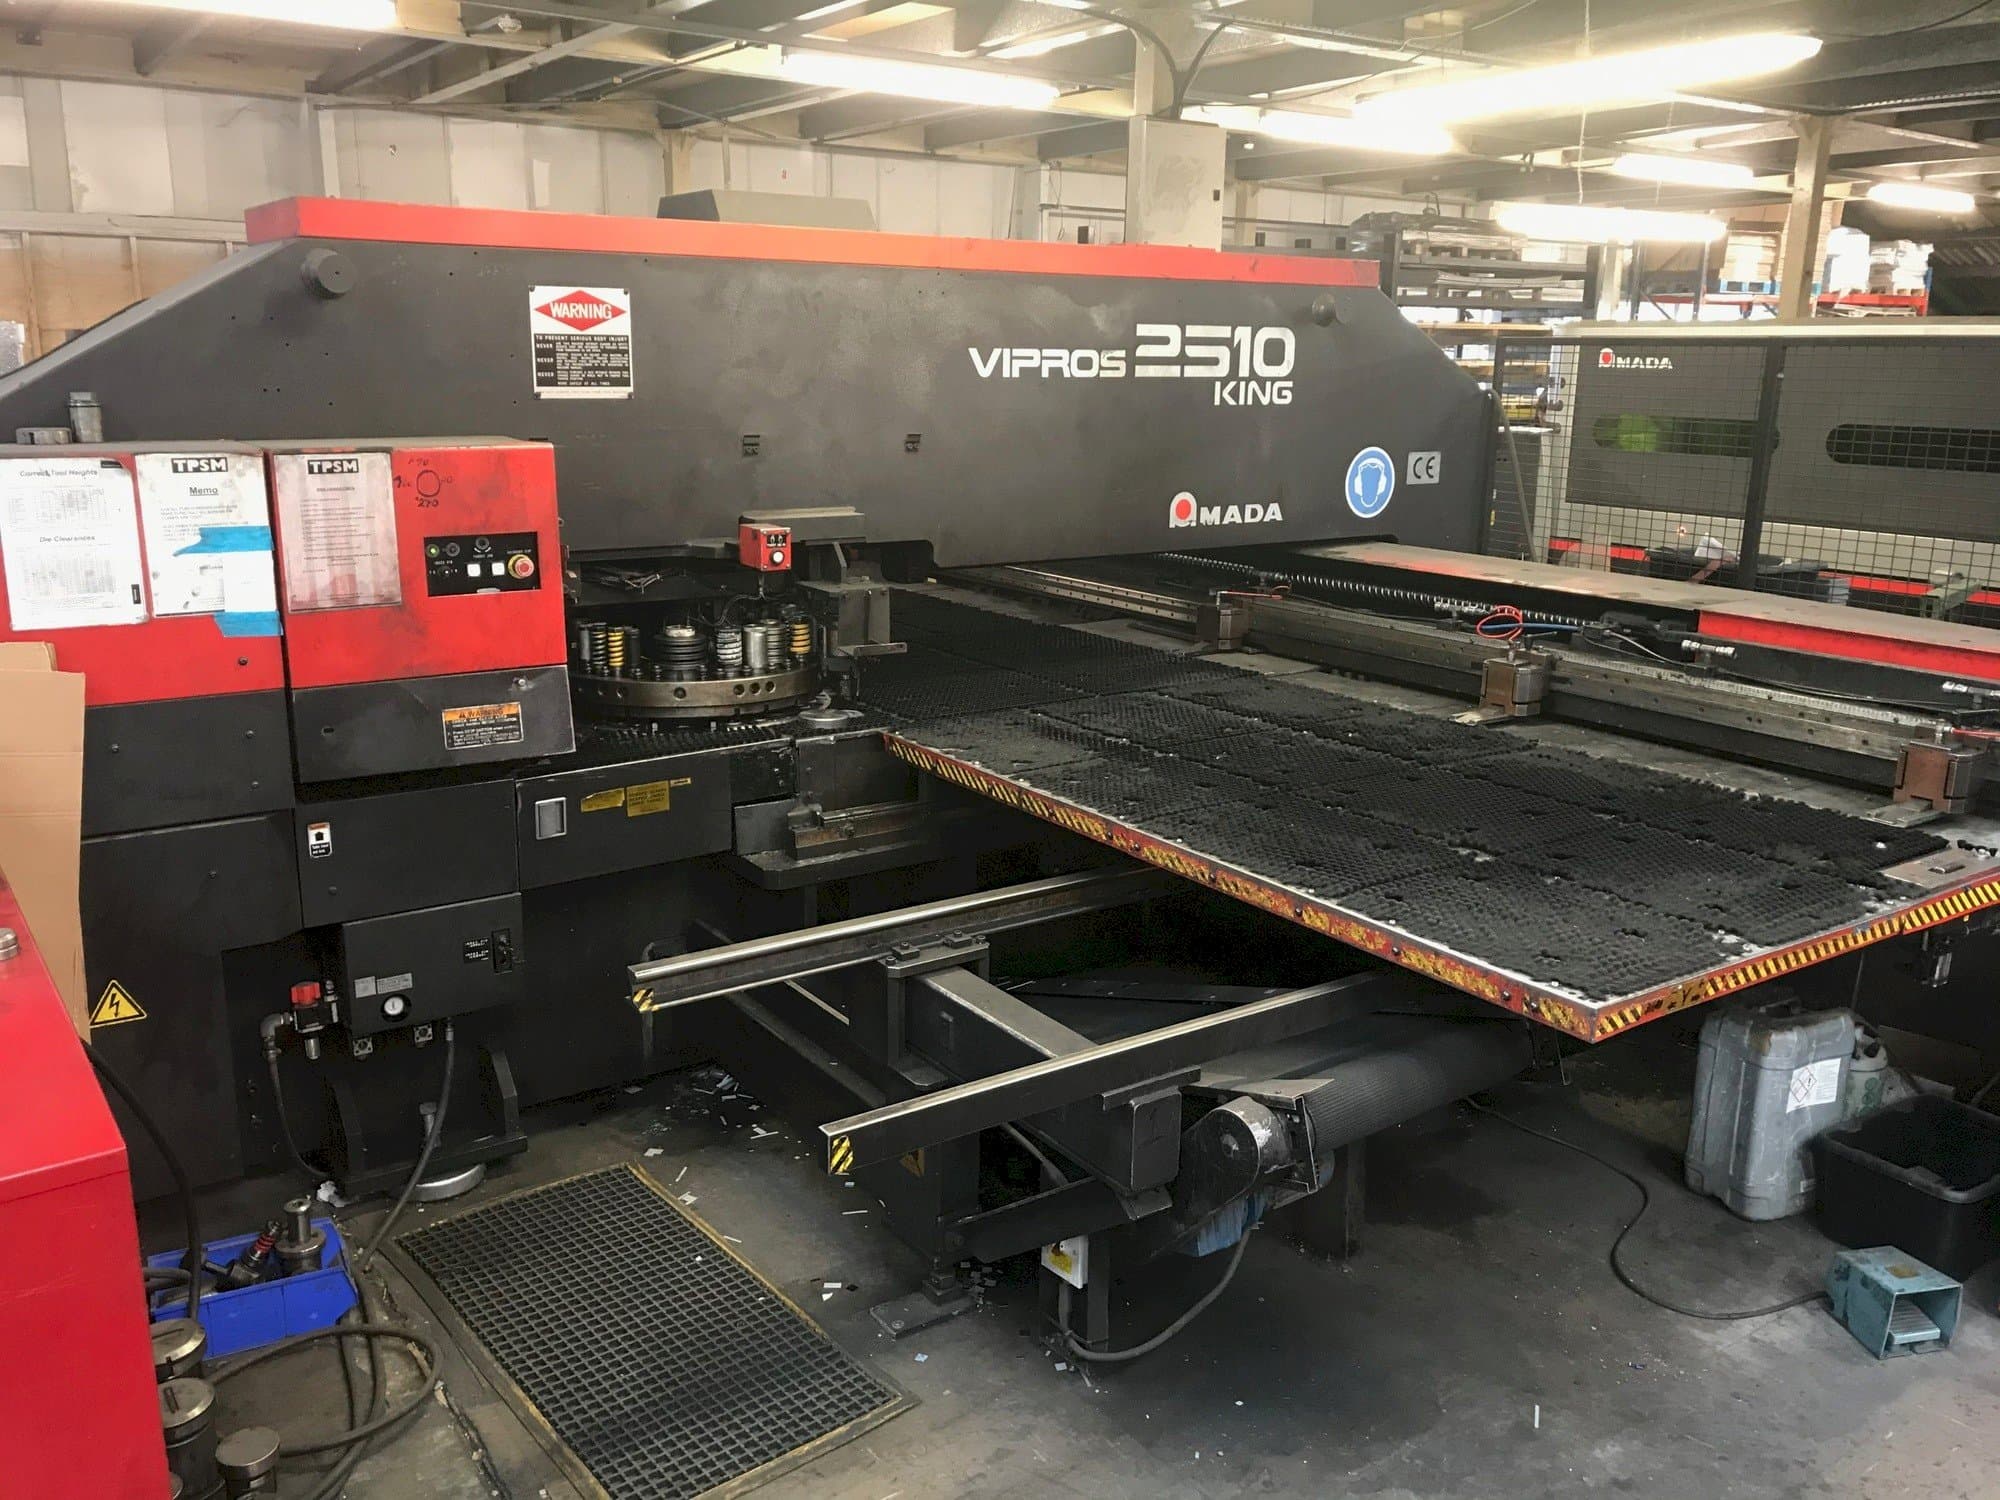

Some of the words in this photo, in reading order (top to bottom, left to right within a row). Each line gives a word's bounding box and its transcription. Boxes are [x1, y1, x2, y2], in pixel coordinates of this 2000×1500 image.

[549, 301, 612, 320] WARNING
[968, 347, 1127, 378] VIPROS
[1134, 323, 1296, 378] 2510
[1598, 347, 1673, 370] AMADA
[1213, 380, 1294, 406] KING
[172, 458, 227, 473] TPSM
[309, 460, 358, 473] TPSM
[1413, 456, 1435, 479] CE
[189, 486, 218, 495] Memo
[1169, 491, 1284, 528] AMADA
